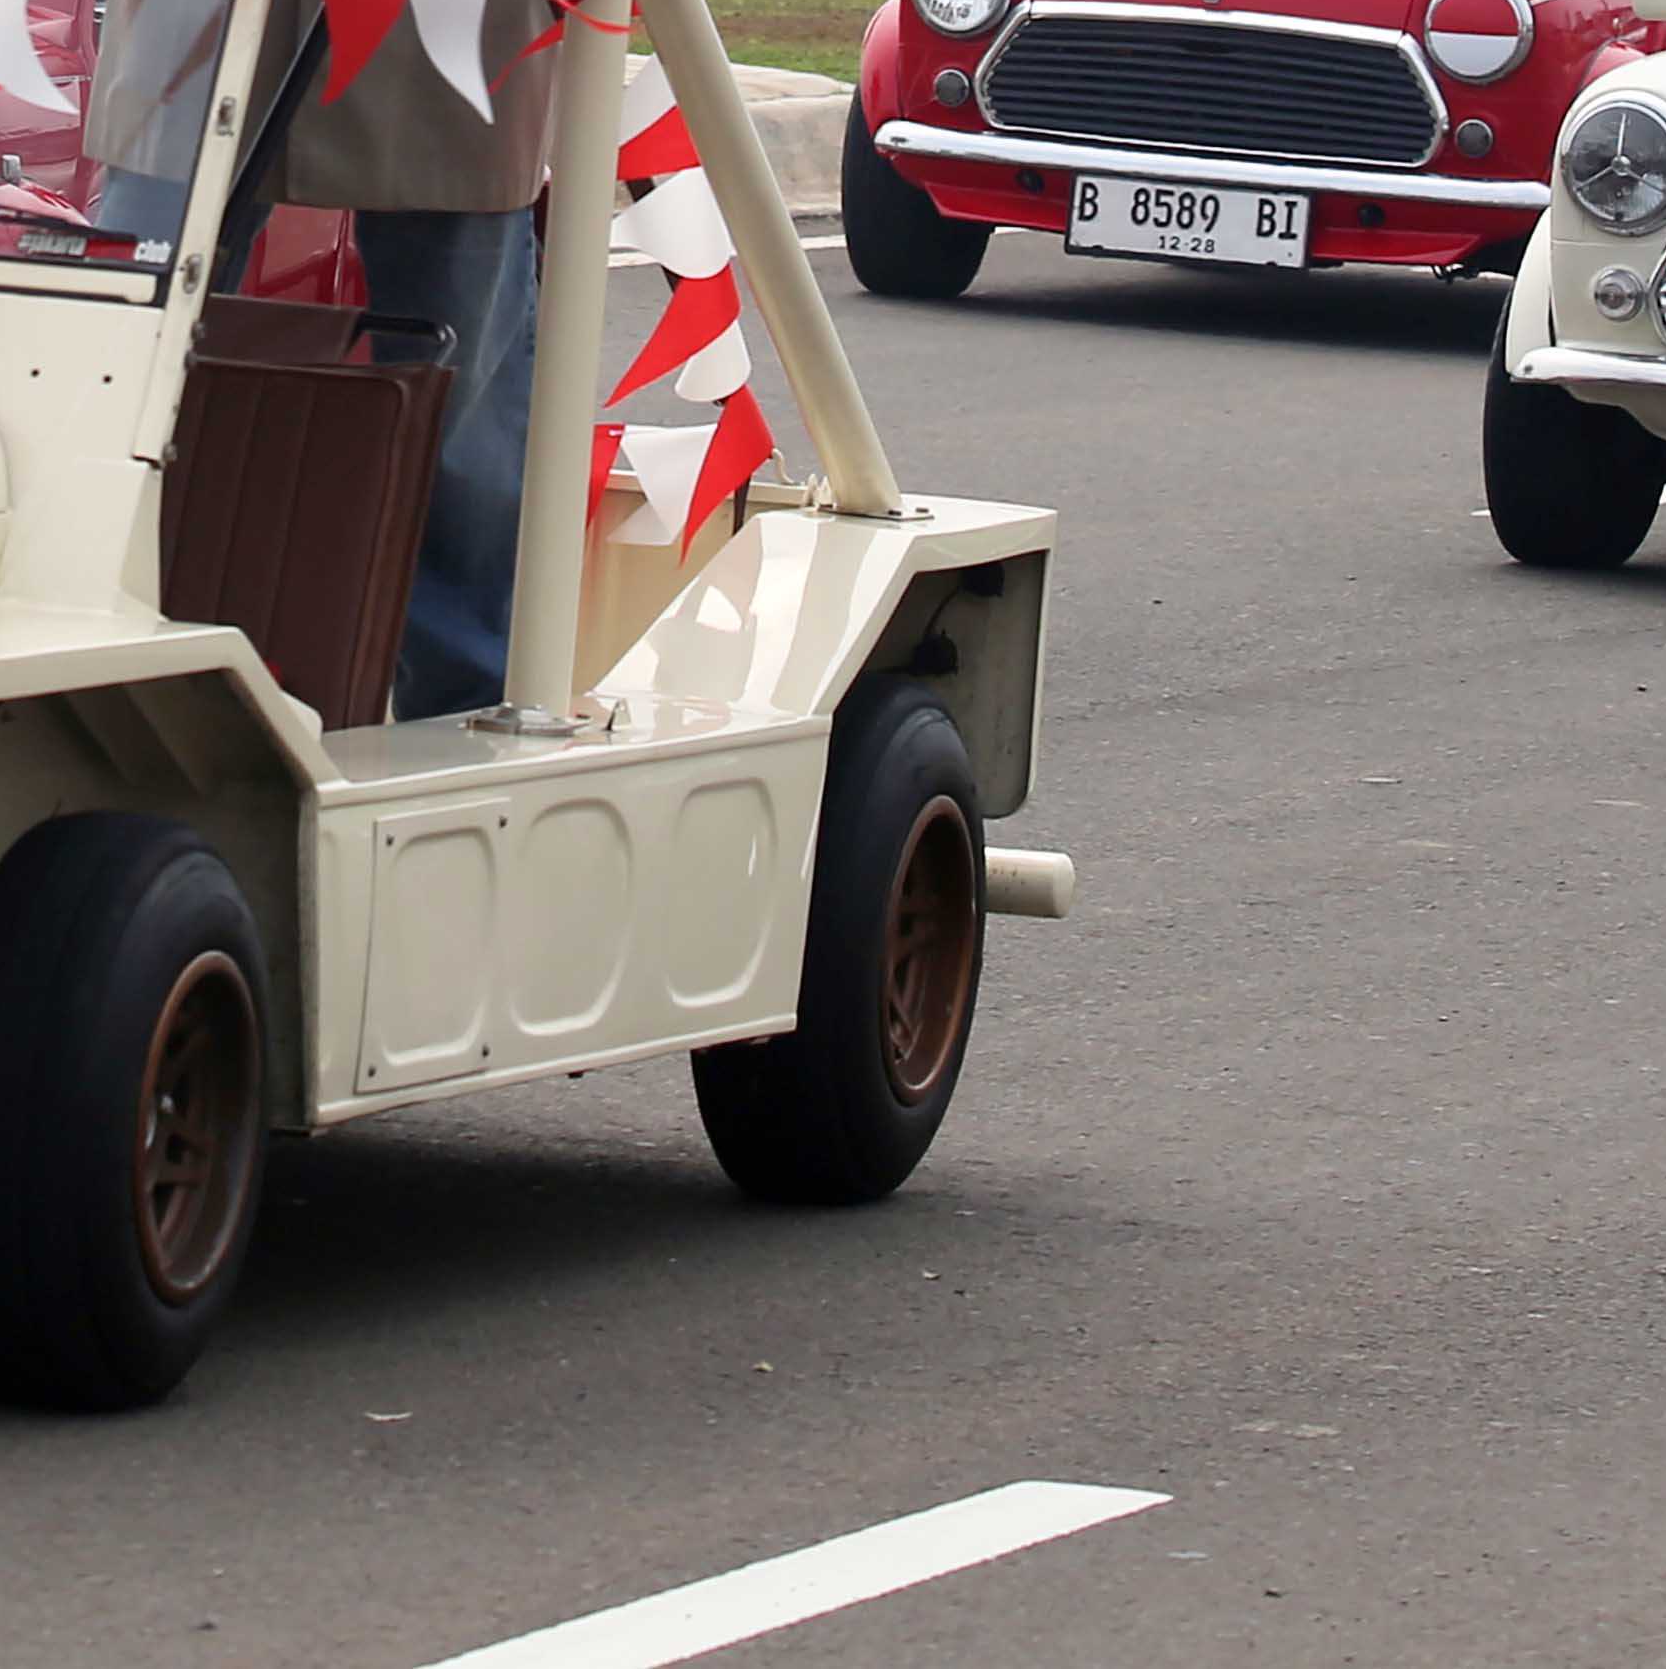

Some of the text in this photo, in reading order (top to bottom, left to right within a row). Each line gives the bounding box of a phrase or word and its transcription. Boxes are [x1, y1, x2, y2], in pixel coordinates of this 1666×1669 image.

[1078, 182, 1299, 241] B 8589 BI
